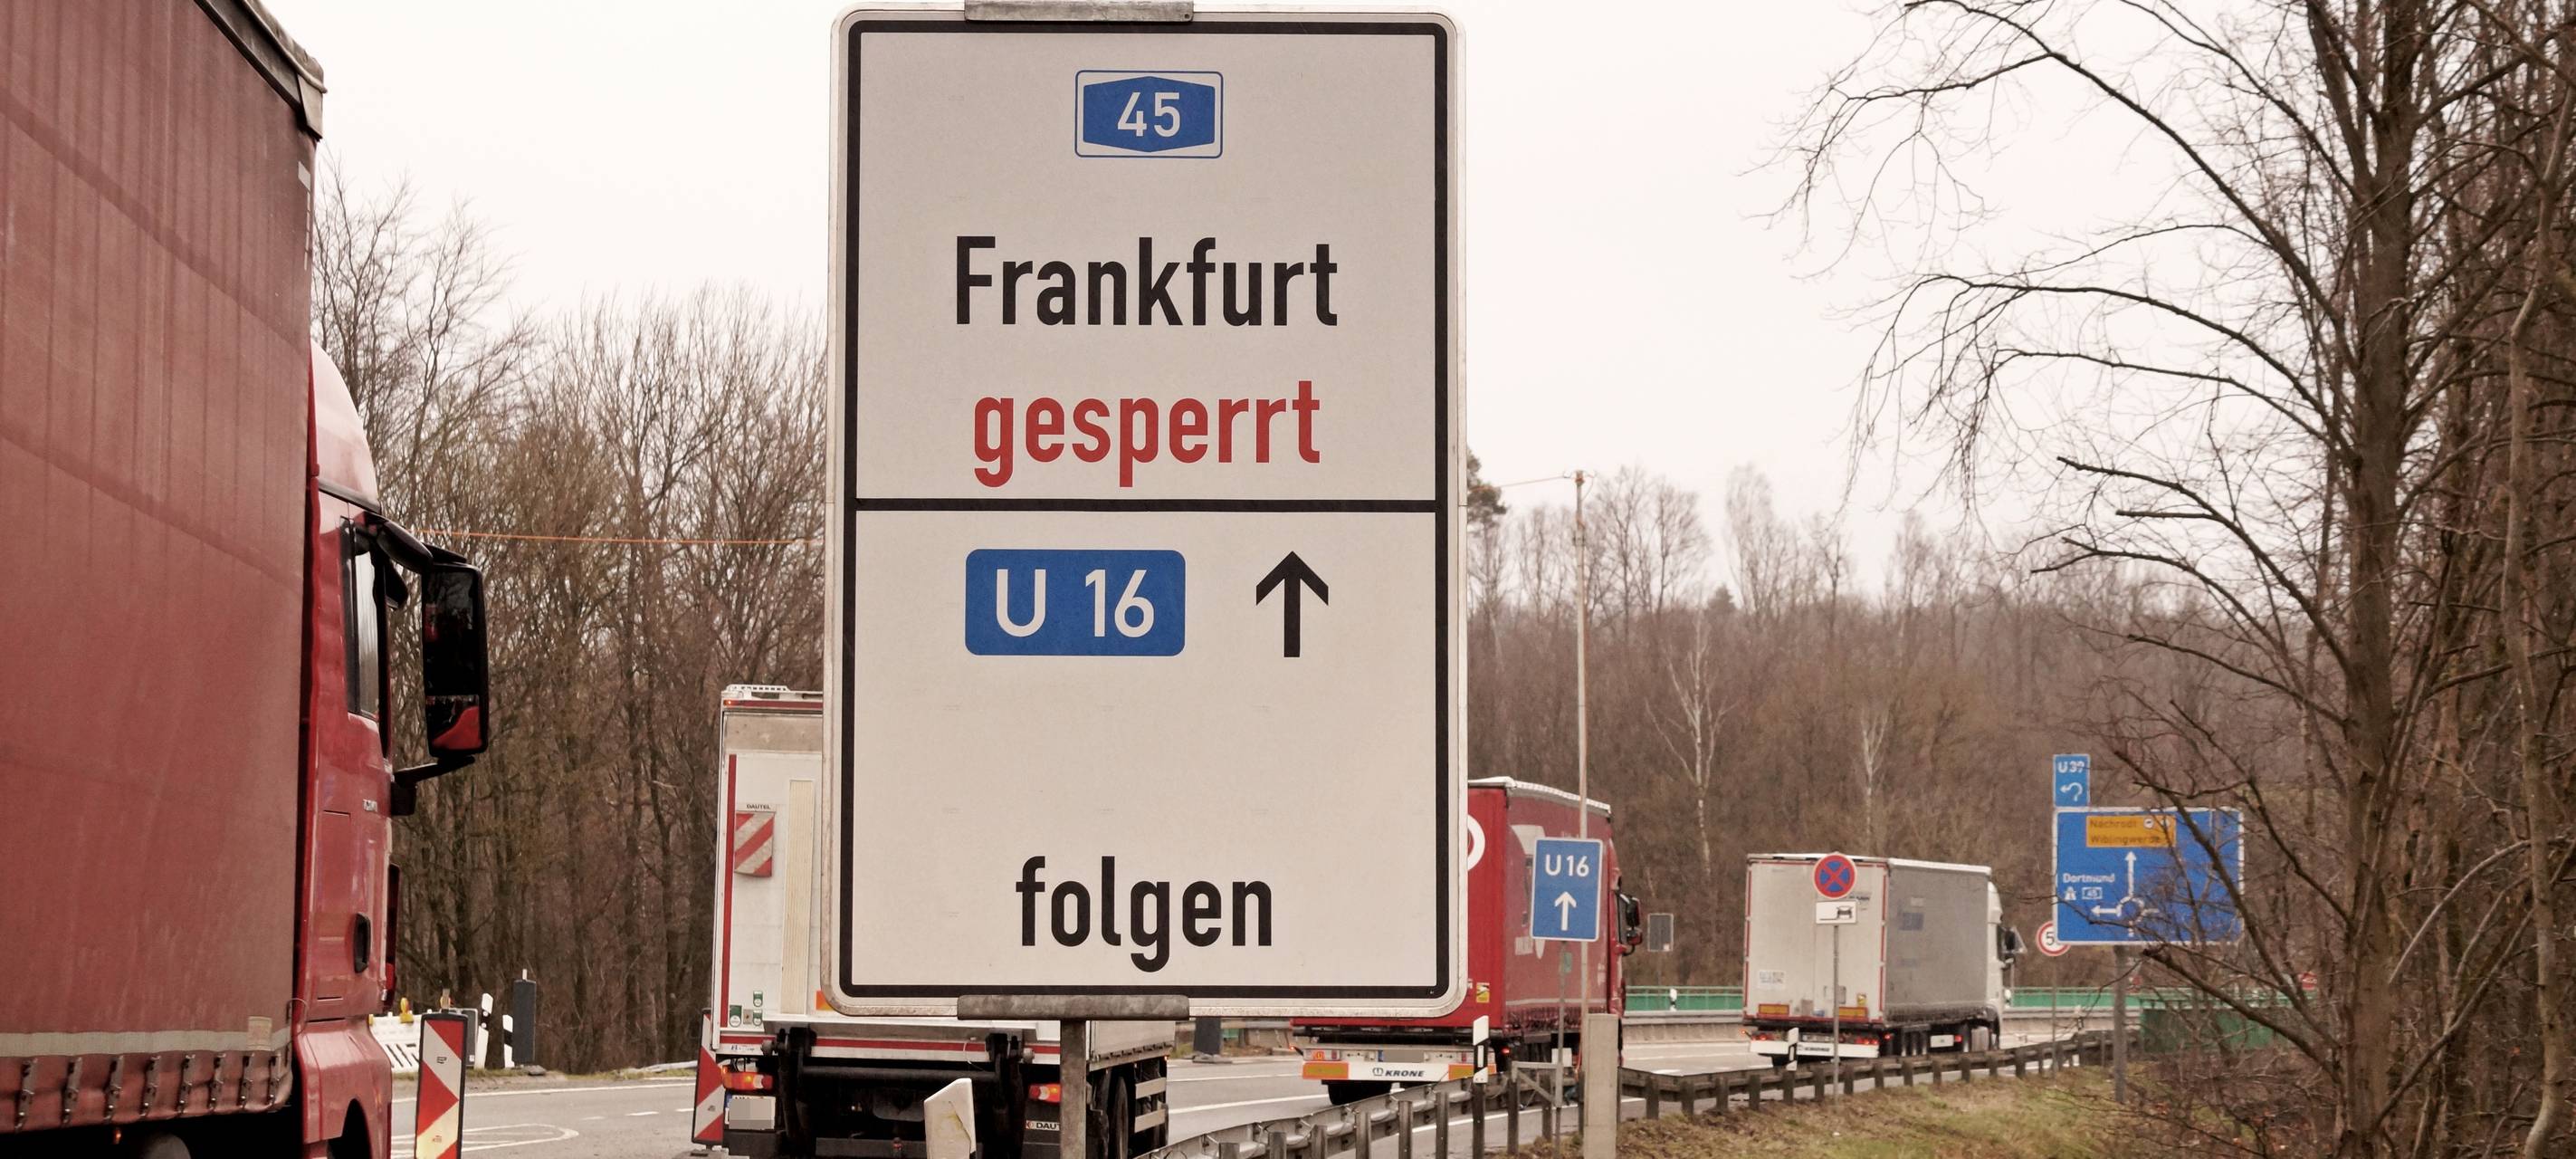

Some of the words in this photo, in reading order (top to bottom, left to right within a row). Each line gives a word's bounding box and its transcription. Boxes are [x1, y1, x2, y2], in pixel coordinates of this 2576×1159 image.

[1118, 91, 1180, 138] 45
[956, 235, 1338, 326] Frankfurt
[974, 379, 1321, 488] gesperrt
[996, 569, 1046, 637] U
[1085, 569, 1155, 638] 16
[2058, 761, 2068, 773] U
[1545, 854, 1562, 876] U
[1566, 855, 1589, 877] 16
[2063, 873, 2115, 884] Dortmund
[1016, 856, 1273, 972] folgen
